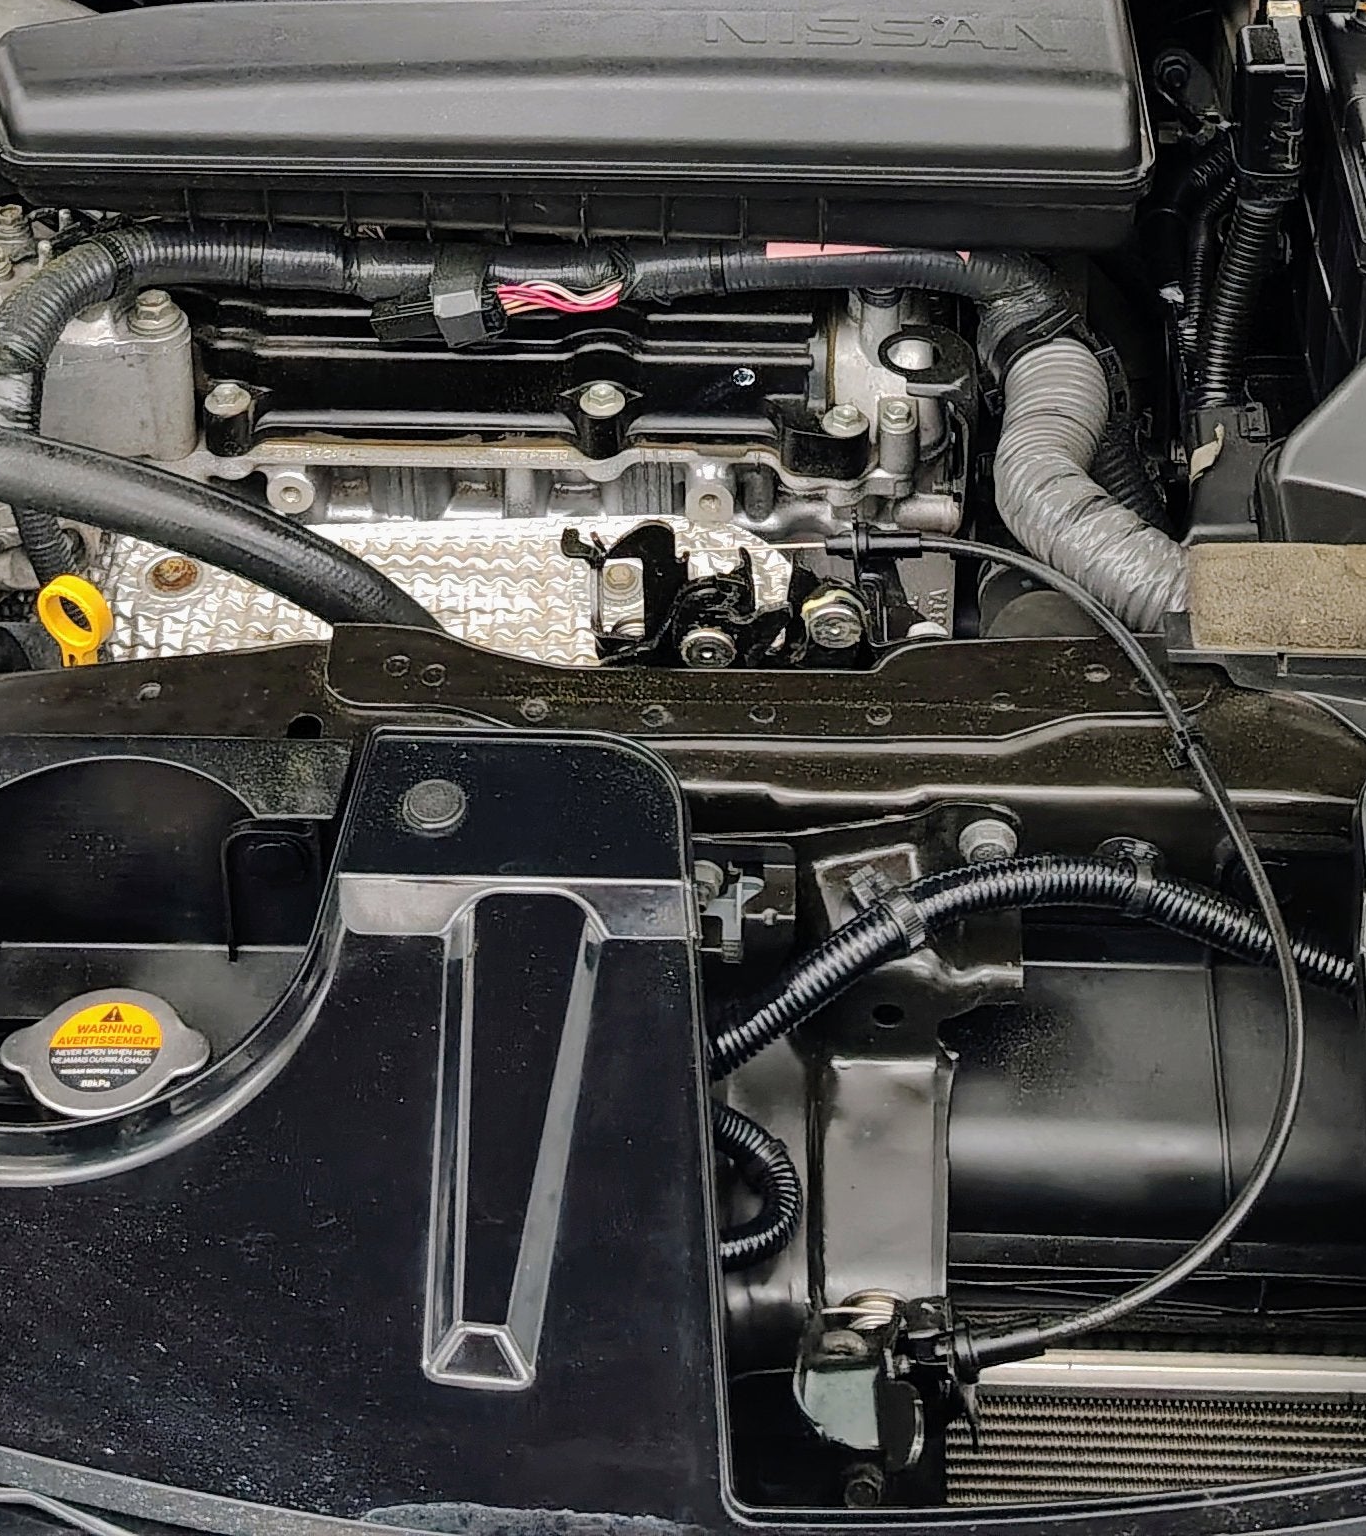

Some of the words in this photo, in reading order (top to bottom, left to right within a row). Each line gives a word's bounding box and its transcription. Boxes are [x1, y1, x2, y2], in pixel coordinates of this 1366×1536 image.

[704, 13, 1068, 52] NISSAN
[77, 1024, 143, 1034] WARNING
[57, 1036, 157, 1045] AVERTISSEMENT
[83, 1048, 106, 1056] OPEN
